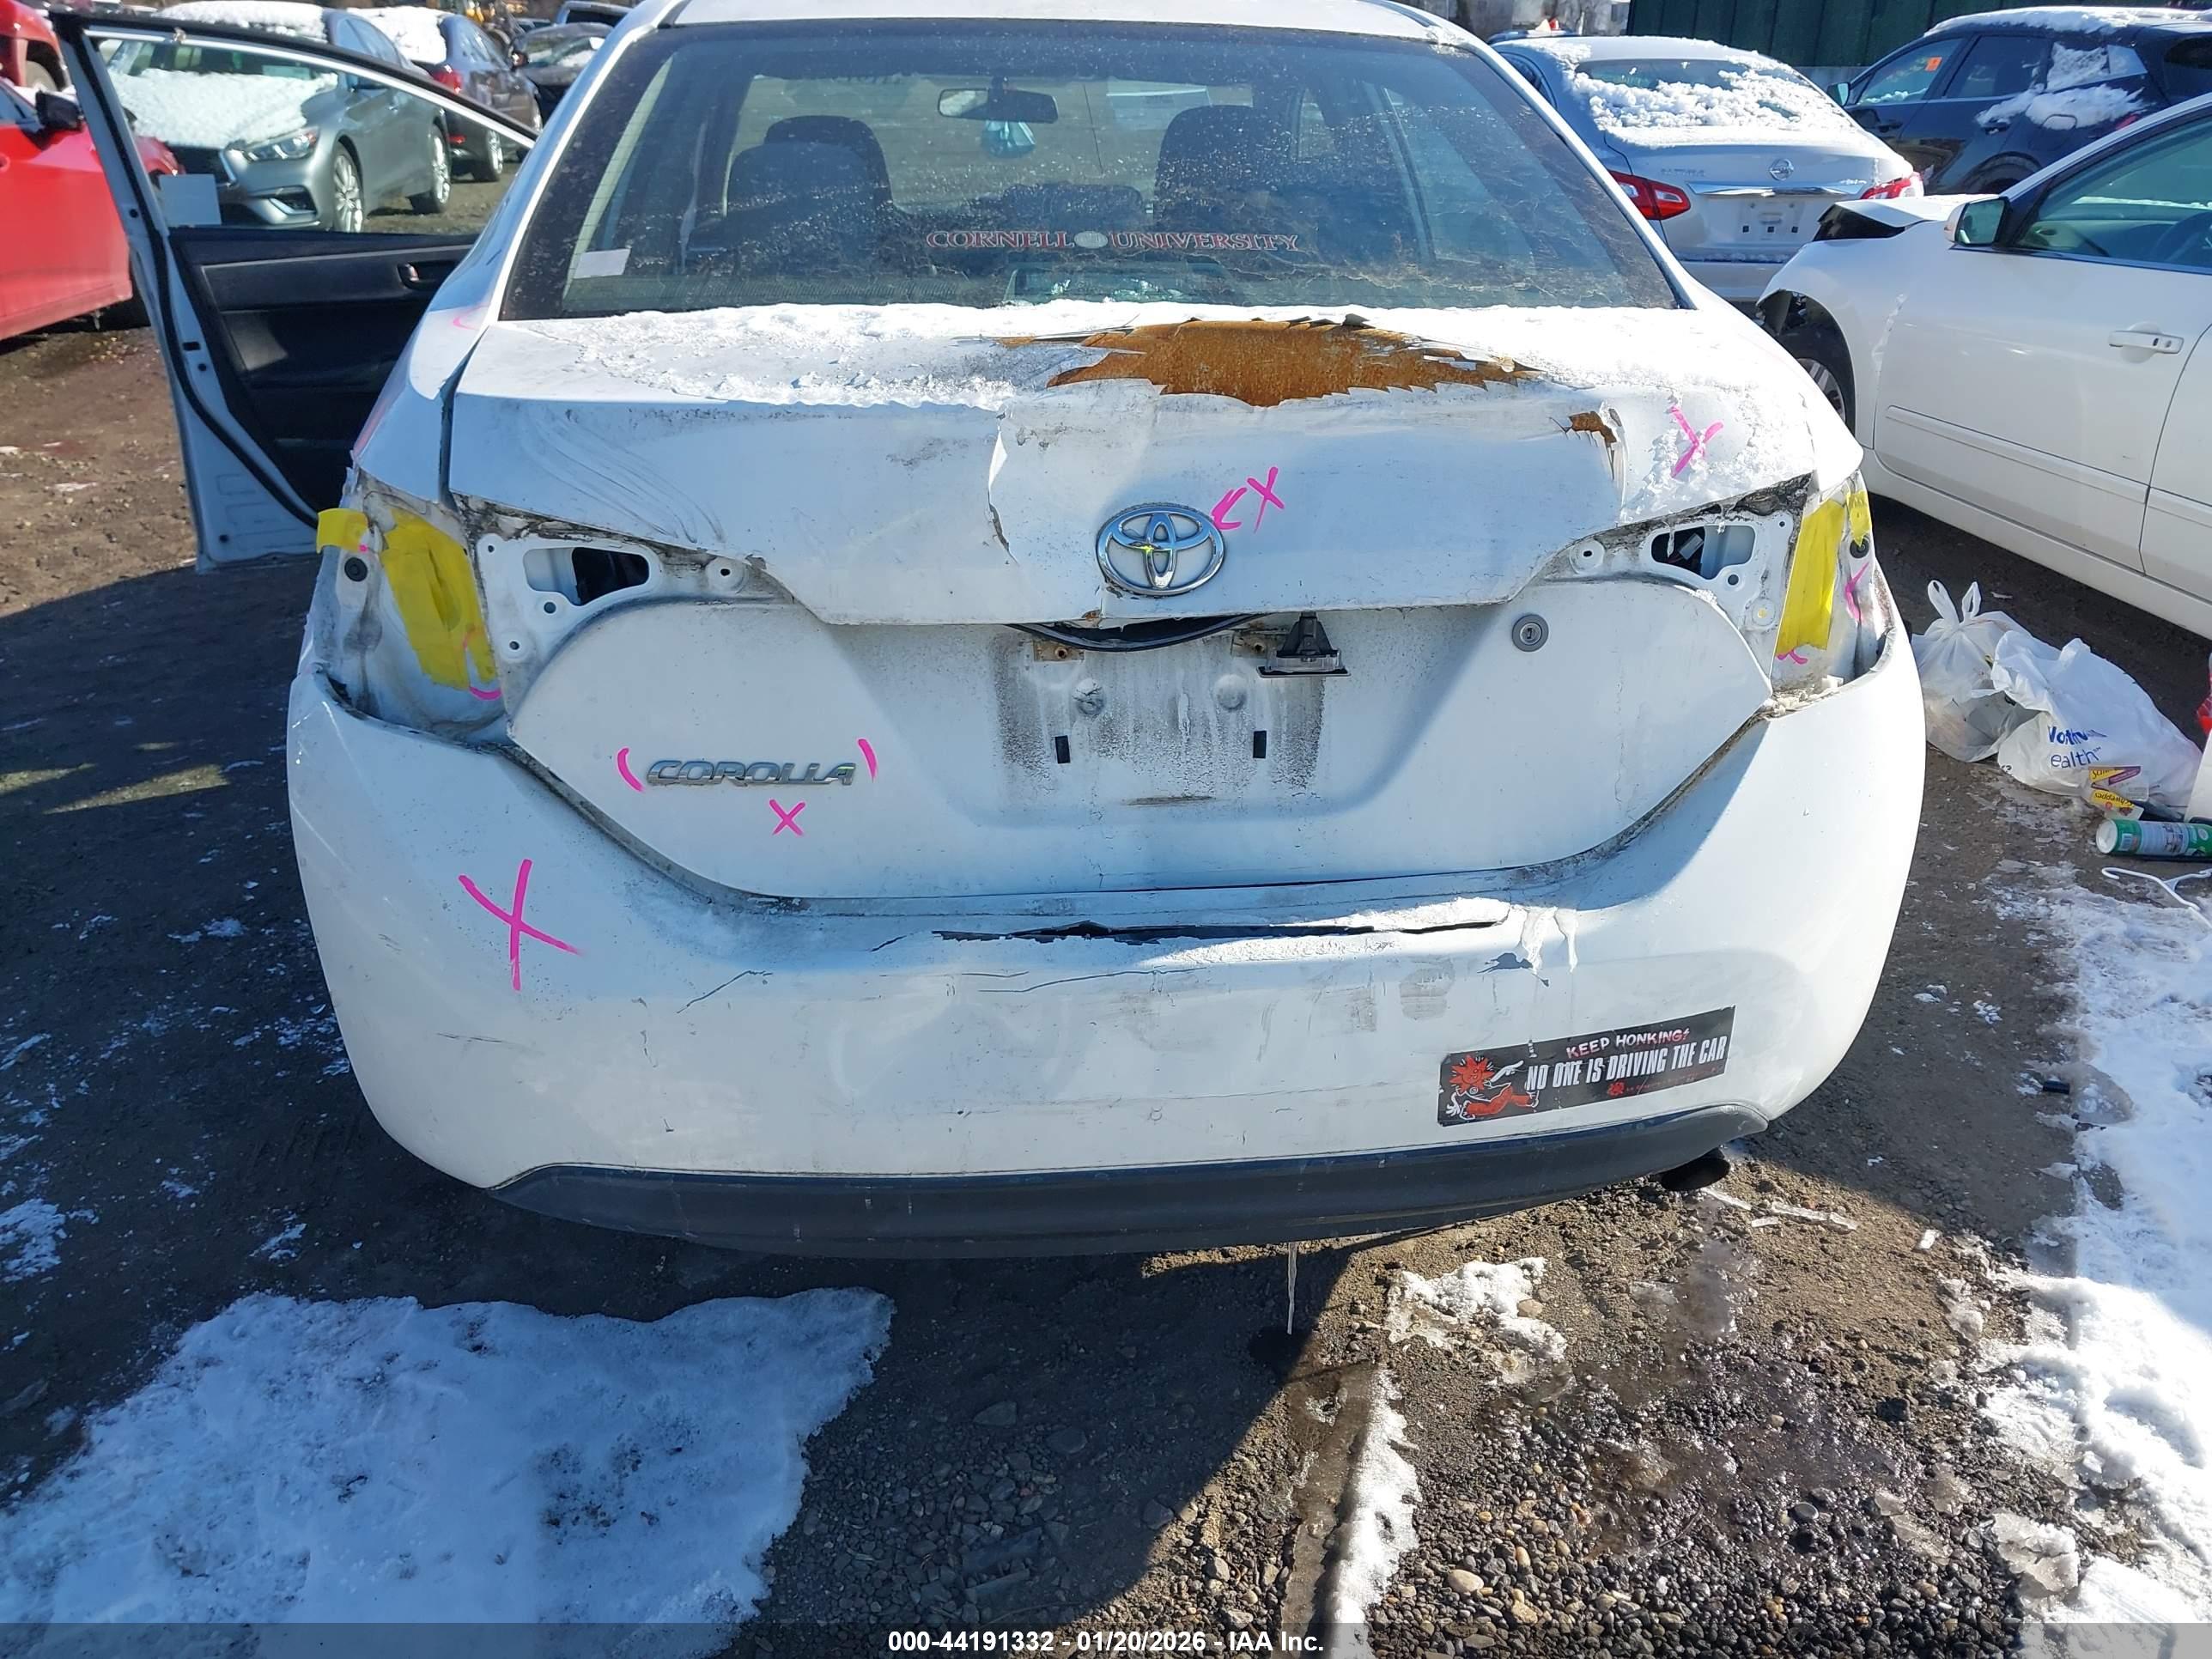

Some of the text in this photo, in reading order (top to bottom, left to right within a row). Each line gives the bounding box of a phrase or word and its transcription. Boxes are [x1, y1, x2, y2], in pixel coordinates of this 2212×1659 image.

[927, 230, 1299, 252] CORNELL UNIVERSITY
[646, 759, 857, 786] COROLLA
[1566, 1037, 1610, 1059] KEEP
[1526, 1064, 1548, 1091] NO
[1553, 1060, 1583, 1087] ONE
[1586, 1057, 1605, 1084] IS
[1606, 1048, 1668, 1080] DRIVING
[1671, 1042, 1698, 1070] THE
[1698, 1036, 1728, 1064] CAR
